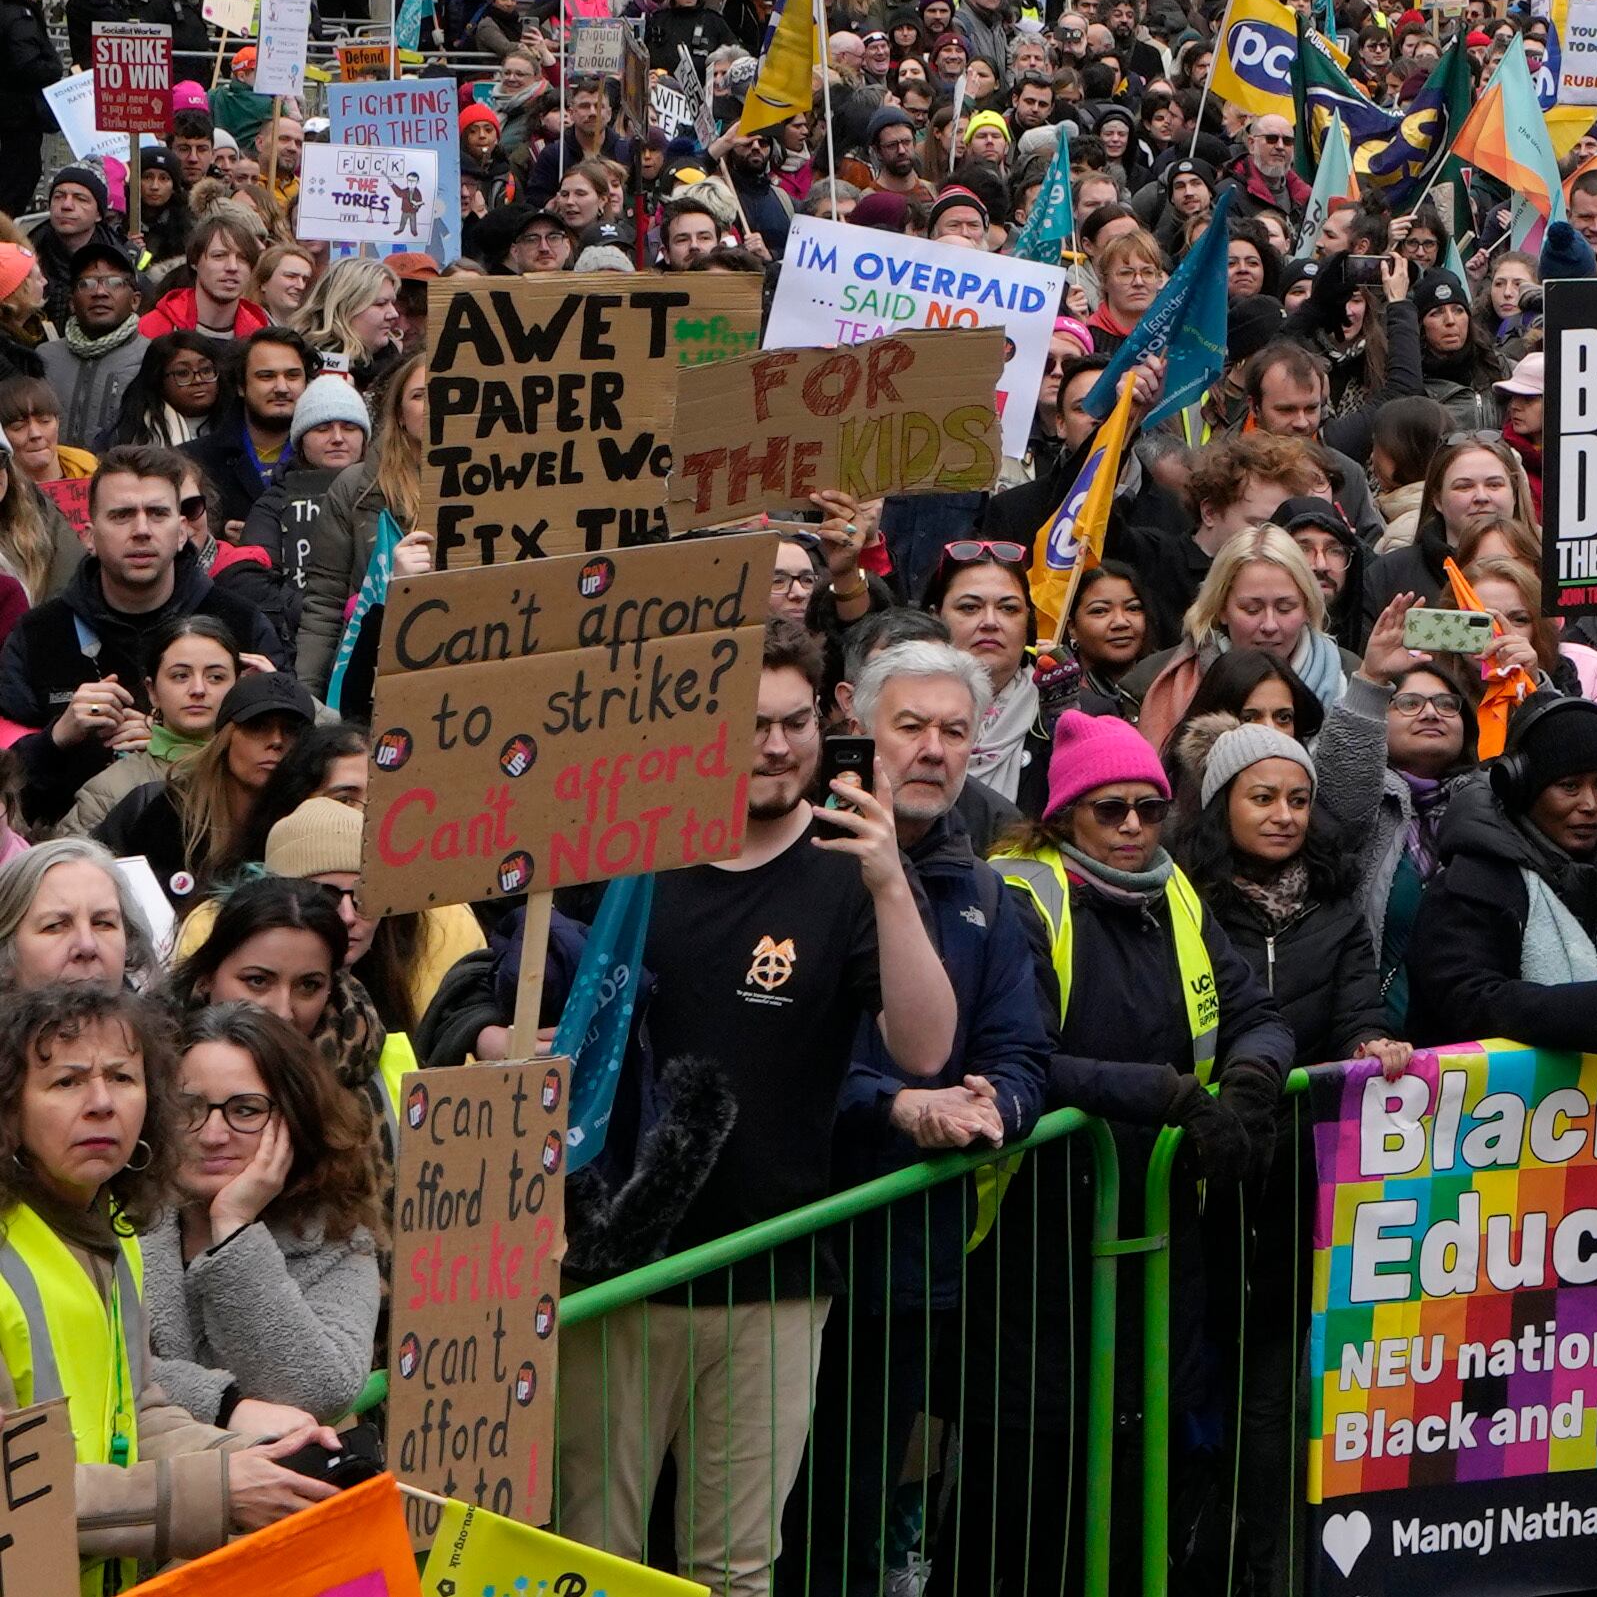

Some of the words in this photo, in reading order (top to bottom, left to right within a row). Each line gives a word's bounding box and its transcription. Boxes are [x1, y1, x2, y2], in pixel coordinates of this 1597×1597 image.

[96, 38, 168, 64] STRIKE
[97, 64, 122, 88] TO
[129, 65, 168, 90] WIN
[345, 51, 384, 64] Defend
[1568, 41, 1585, 53] TO
[342, 89, 451, 116] FIGHTING
[840, 285, 916, 321] SAID
[925, 301, 979, 329] NO
[426, 370, 624, 446] PAPER
[750, 341, 917, 425] FOR
[426, 441, 584, 499] TOWEL
[681, 434, 825, 515] THE
[839, 404, 999, 496] KIDS
[395, 588, 542, 671] Can't
[577, 561, 749, 673] afford
[1557, 587, 1585, 606] JOIN
[432, 693, 493, 751] to
[543, 639, 740, 737] strike?
[378, 784, 517, 869] Can't
[554, 721, 731, 823] afford
[429, 1071, 529, 1146] can't
[401, 1161, 486, 1234] afford
[507, 1154, 546, 1216] to
[409, 1216, 555, 1311] strike?
[422, 1305, 508, 1385] can't
[1338, 1333, 1447, 1392] NEU
[401, 1395, 510, 1471] afford
[1332, 1406, 1478, 1464] Black
[1488, 1393, 1586, 1446] and
[447, 1503, 479, 1570] neu.org.uk
[1391, 1506, 1497, 1558] Manoj
